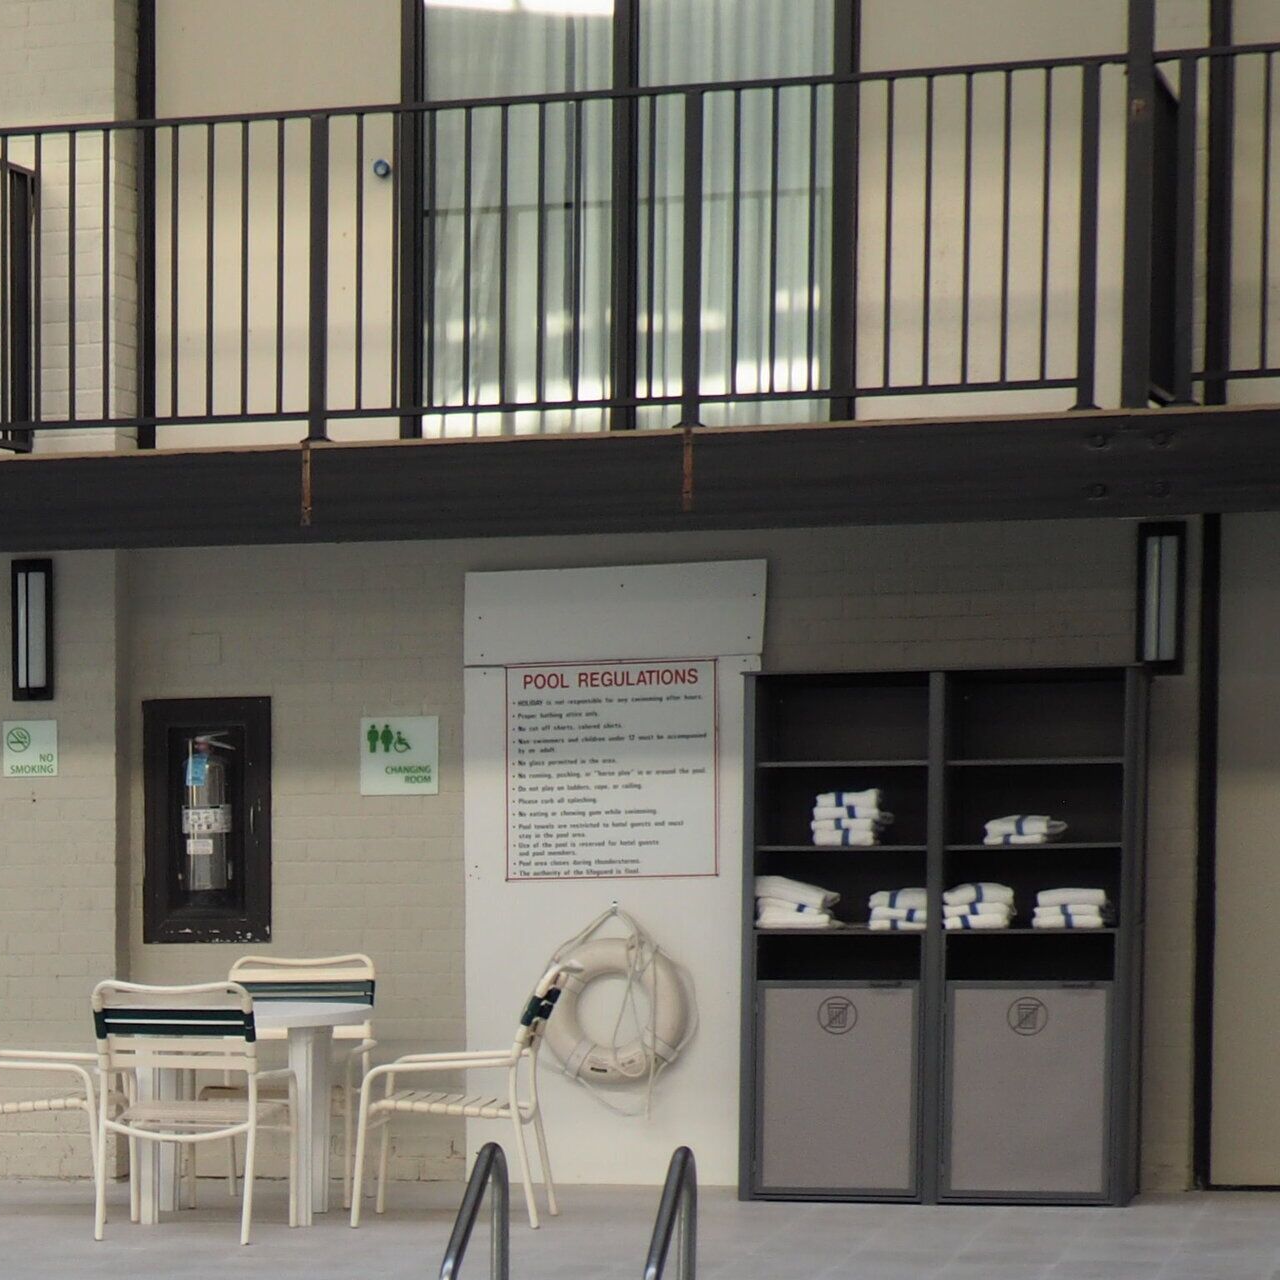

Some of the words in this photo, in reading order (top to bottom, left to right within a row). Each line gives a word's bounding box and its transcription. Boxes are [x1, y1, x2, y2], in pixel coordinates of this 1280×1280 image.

[523, 673, 570, 690] POOL
[578, 668, 699, 688] REGULATIONS
[40, 753, 54, 762] NO
[10, 764, 54, 774] SMOKING
[385, 765, 432, 775] CHANGING
[405, 775, 432, 784] ROOM
